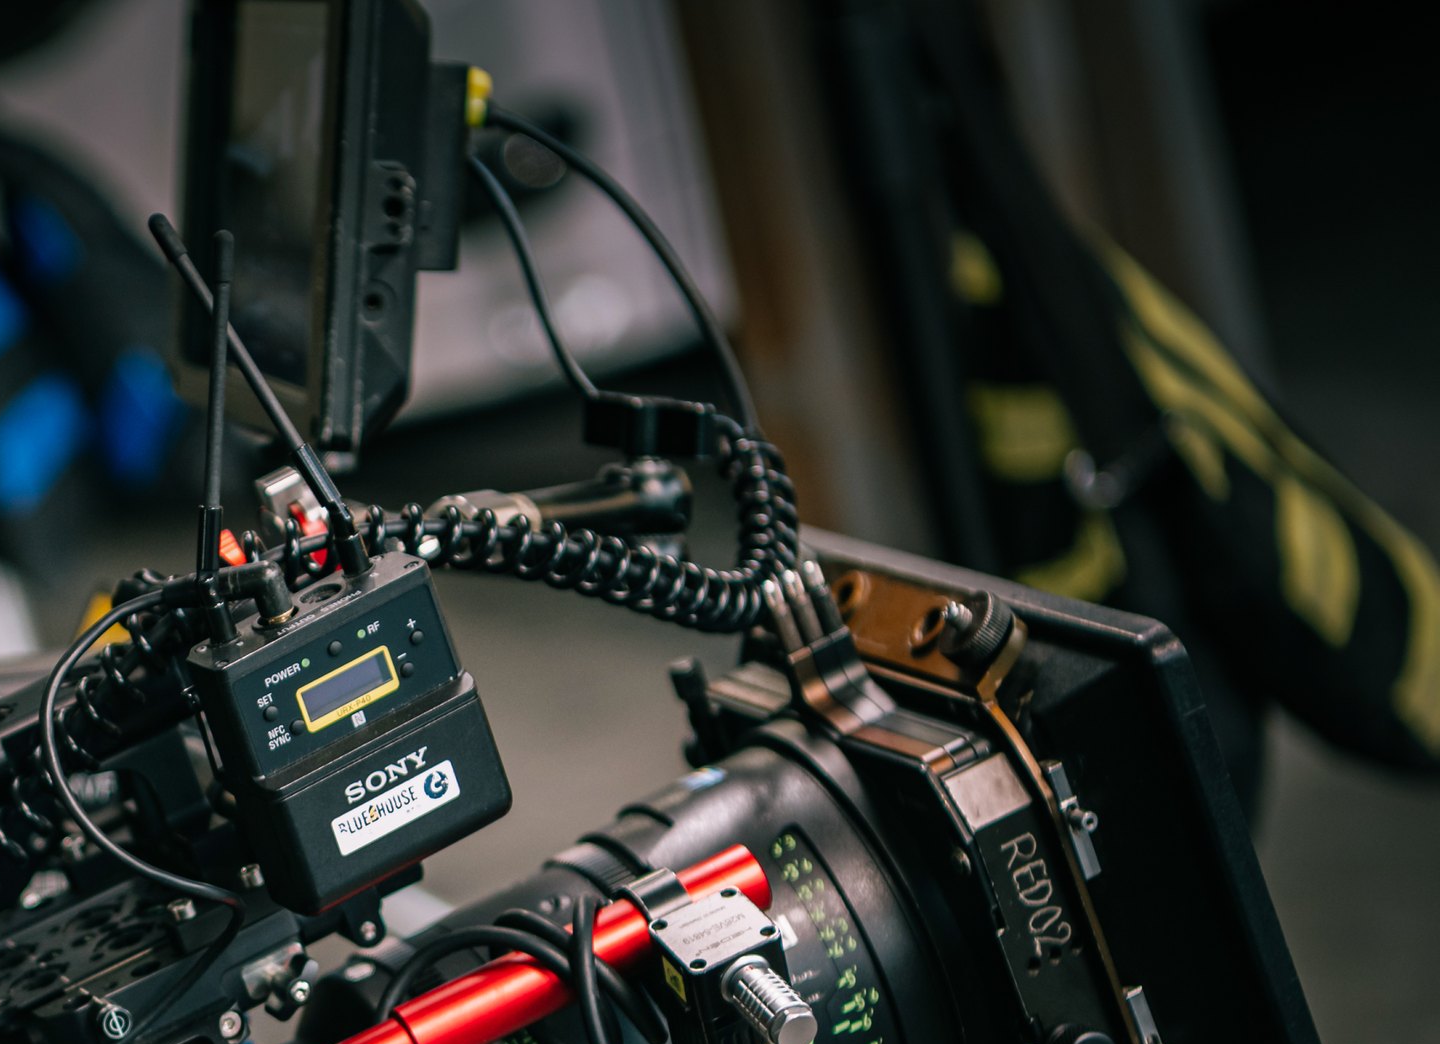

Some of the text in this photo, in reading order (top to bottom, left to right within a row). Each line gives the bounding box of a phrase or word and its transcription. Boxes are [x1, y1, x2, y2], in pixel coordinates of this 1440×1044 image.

[366, 620, 380, 634] RF
[264, 662, 301, 688] POWER
[256, 693, 274, 708] SET
[267, 724, 286, 740] NFC
[268, 732, 292, 751] SYNC
[344, 745, 428, 805] SONY
